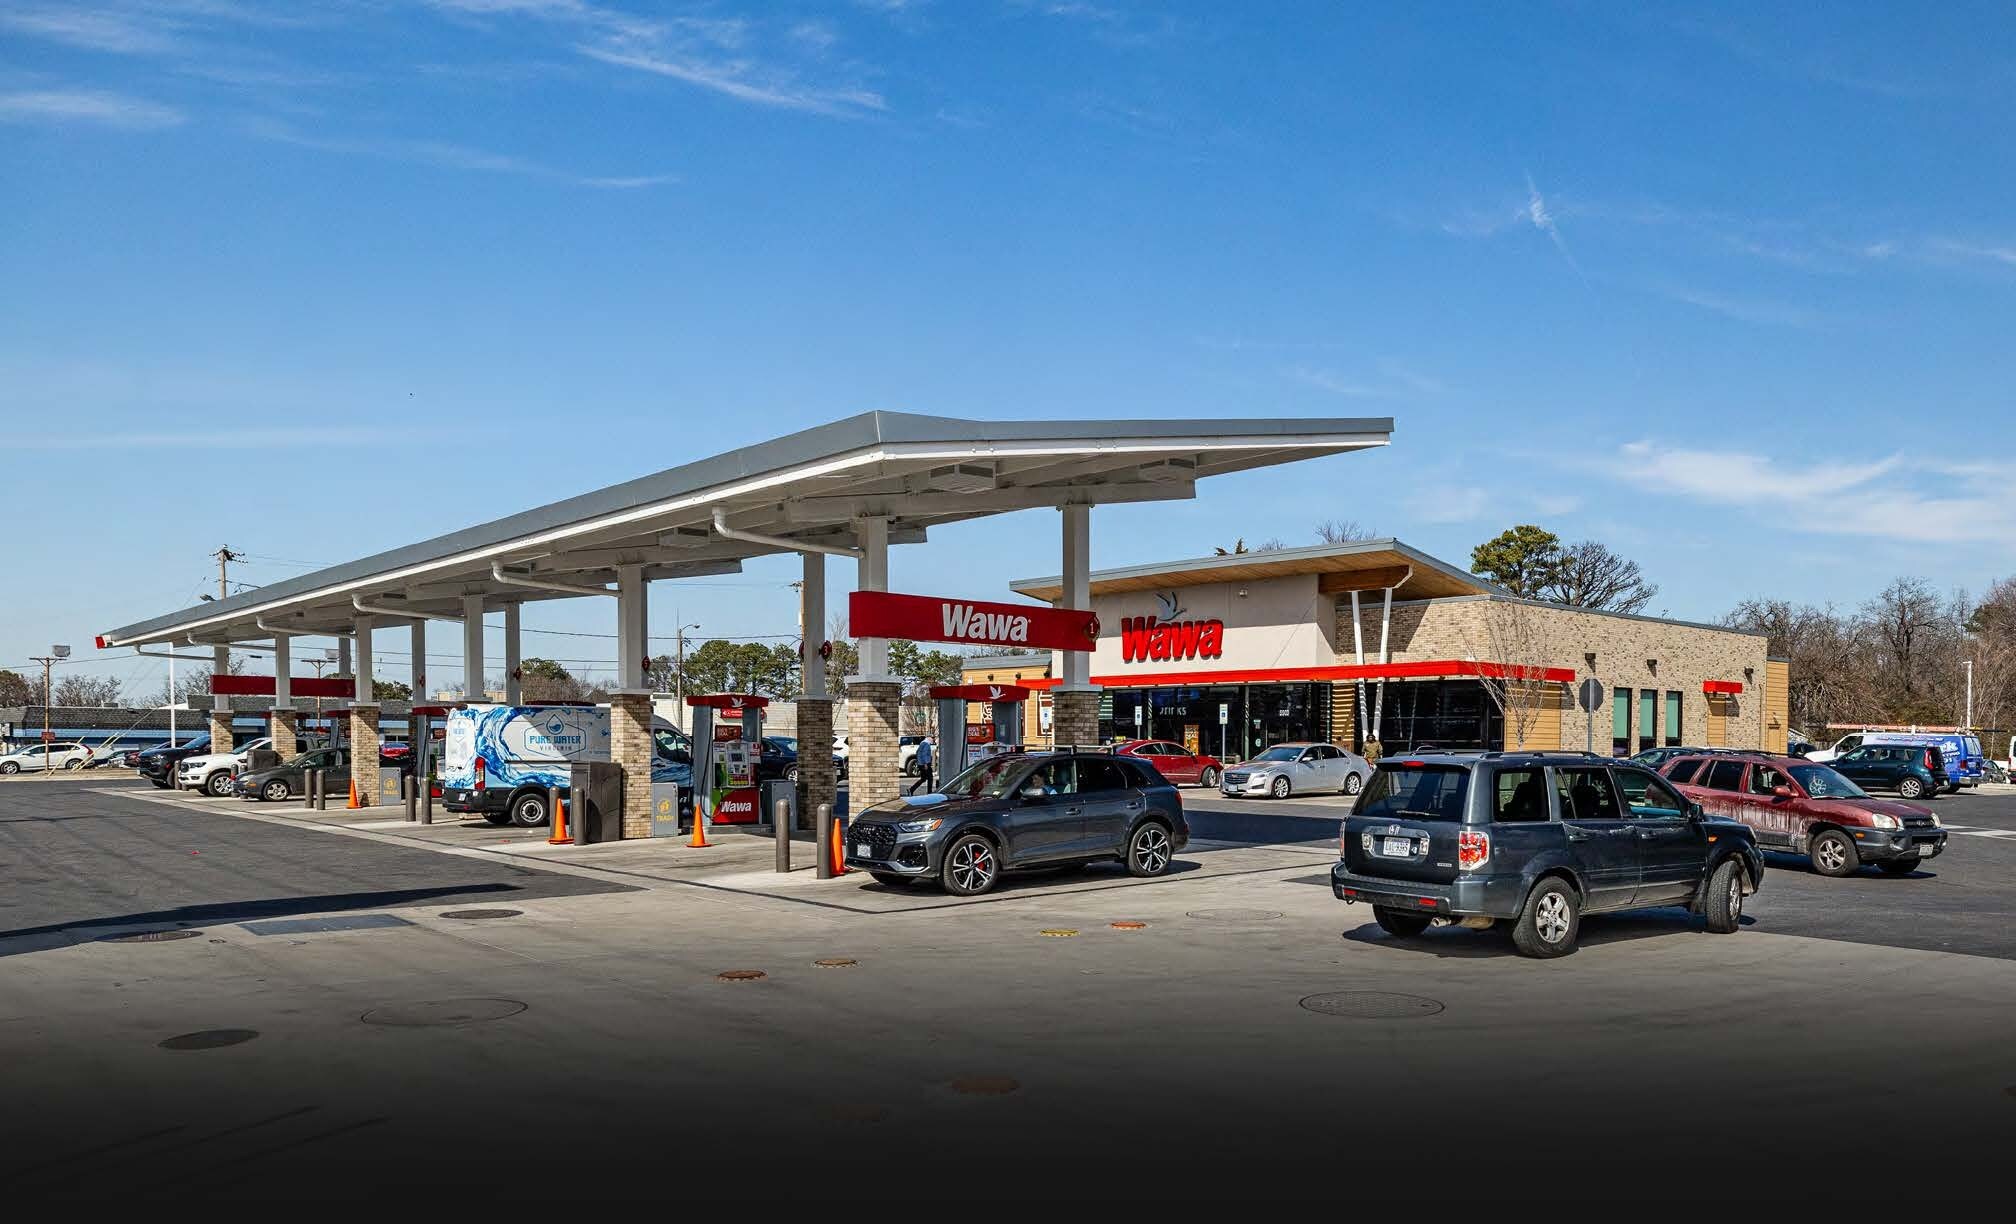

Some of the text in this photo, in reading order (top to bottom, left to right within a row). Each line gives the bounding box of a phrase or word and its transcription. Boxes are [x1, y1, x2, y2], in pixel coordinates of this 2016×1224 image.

[942, 603, 1028, 642] Wawa
[1090, 622, 1095, 634] 1
[1121, 616, 1223, 663] Wawa
[529, 735, 581, 744] PURE WATER
[720, 800, 752, 813] Wawa
